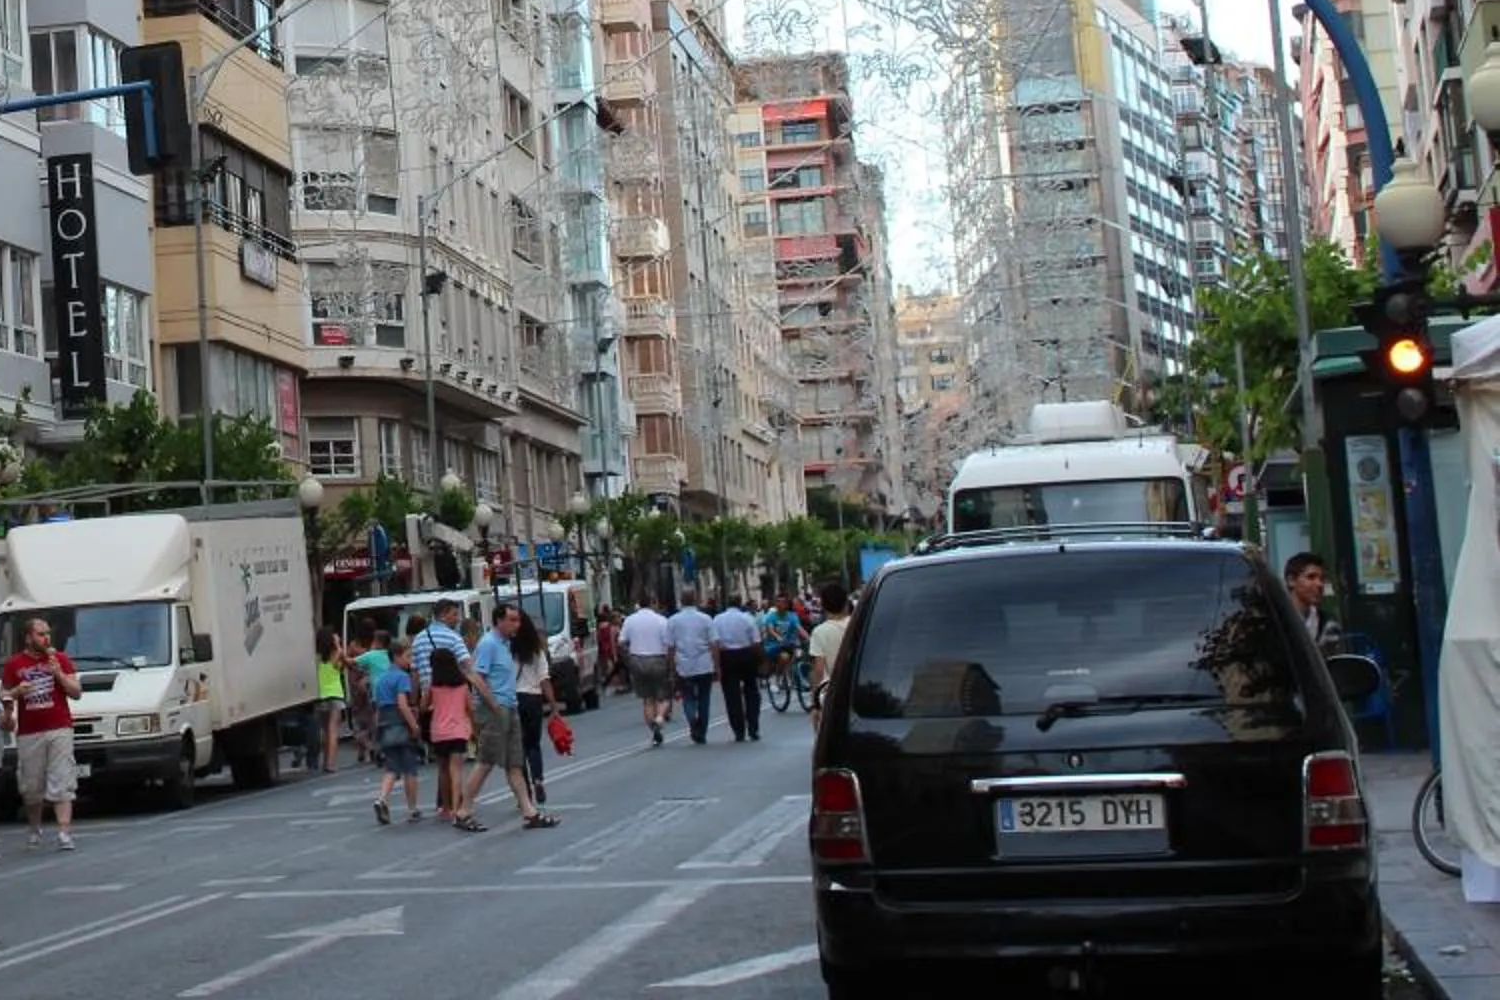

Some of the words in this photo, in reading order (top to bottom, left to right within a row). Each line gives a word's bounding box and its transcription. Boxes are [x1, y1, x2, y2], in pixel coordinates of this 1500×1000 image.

[55, 162, 91, 388] HOTEL
[1019, 801, 1086, 827] 3215
[1102, 800, 1153, 826] DYH
